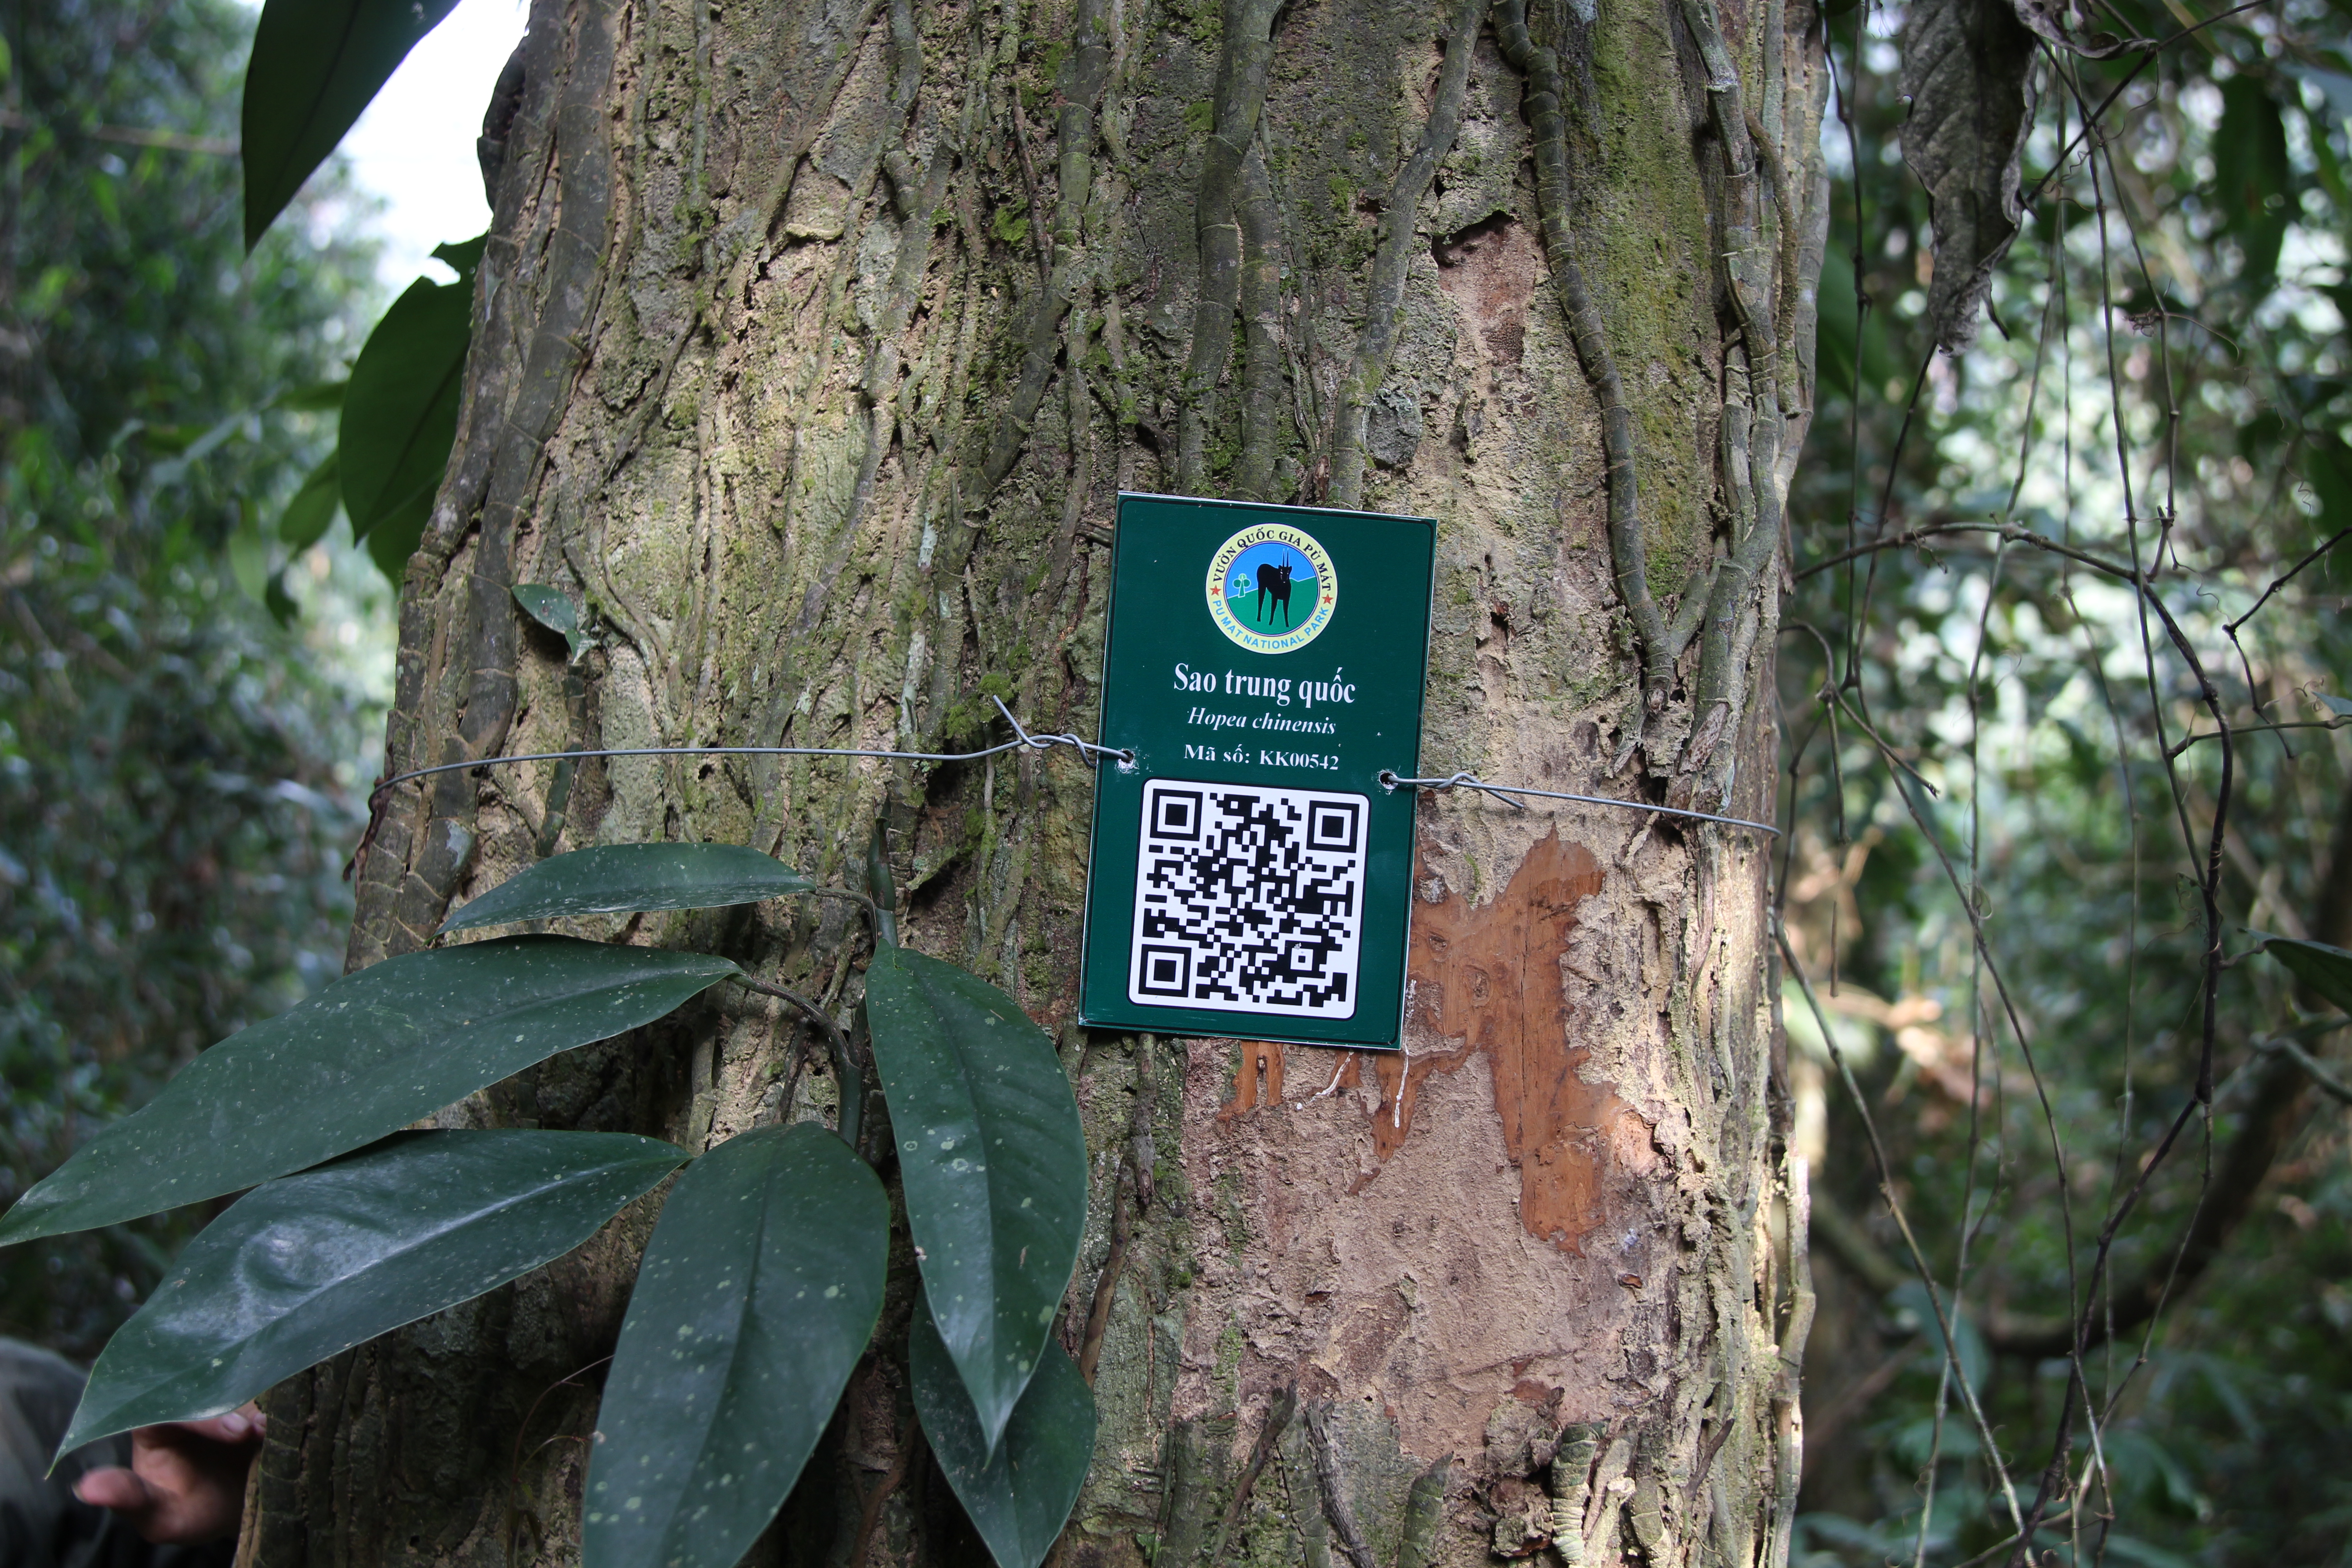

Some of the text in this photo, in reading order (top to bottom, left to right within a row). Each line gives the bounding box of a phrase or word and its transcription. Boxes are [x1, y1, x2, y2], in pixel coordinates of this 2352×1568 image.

[1279, 531, 1301, 547] GIA
[1303, 543, 1321, 560] PÙ
[1213, 600, 1329, 649] PU MAT NATIONAL PARK
[1174, 662, 1356, 708] Sao trung quốc
[1187, 707, 1336, 735] Hopea chinensis
[1183, 744, 1339, 770] Mã số: KK00542
